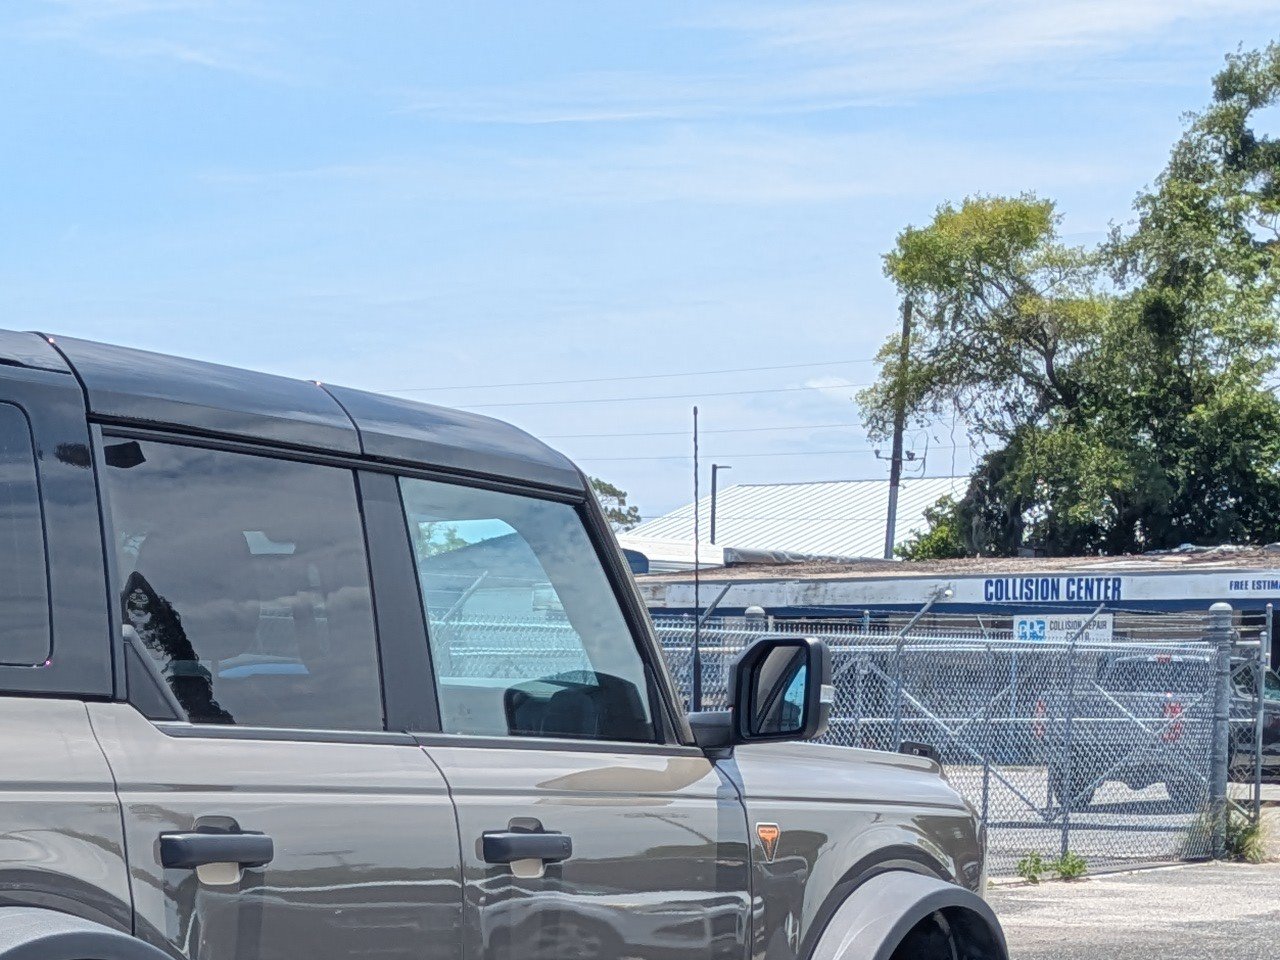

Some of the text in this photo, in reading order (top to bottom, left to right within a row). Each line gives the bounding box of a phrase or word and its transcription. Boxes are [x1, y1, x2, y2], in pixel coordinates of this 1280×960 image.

[984, 577, 1122, 601] COLLISION CENTER
[1230, 580, 1280, 590] FREE ESTIM
[1050, 621, 1081, 630] COLLISION
